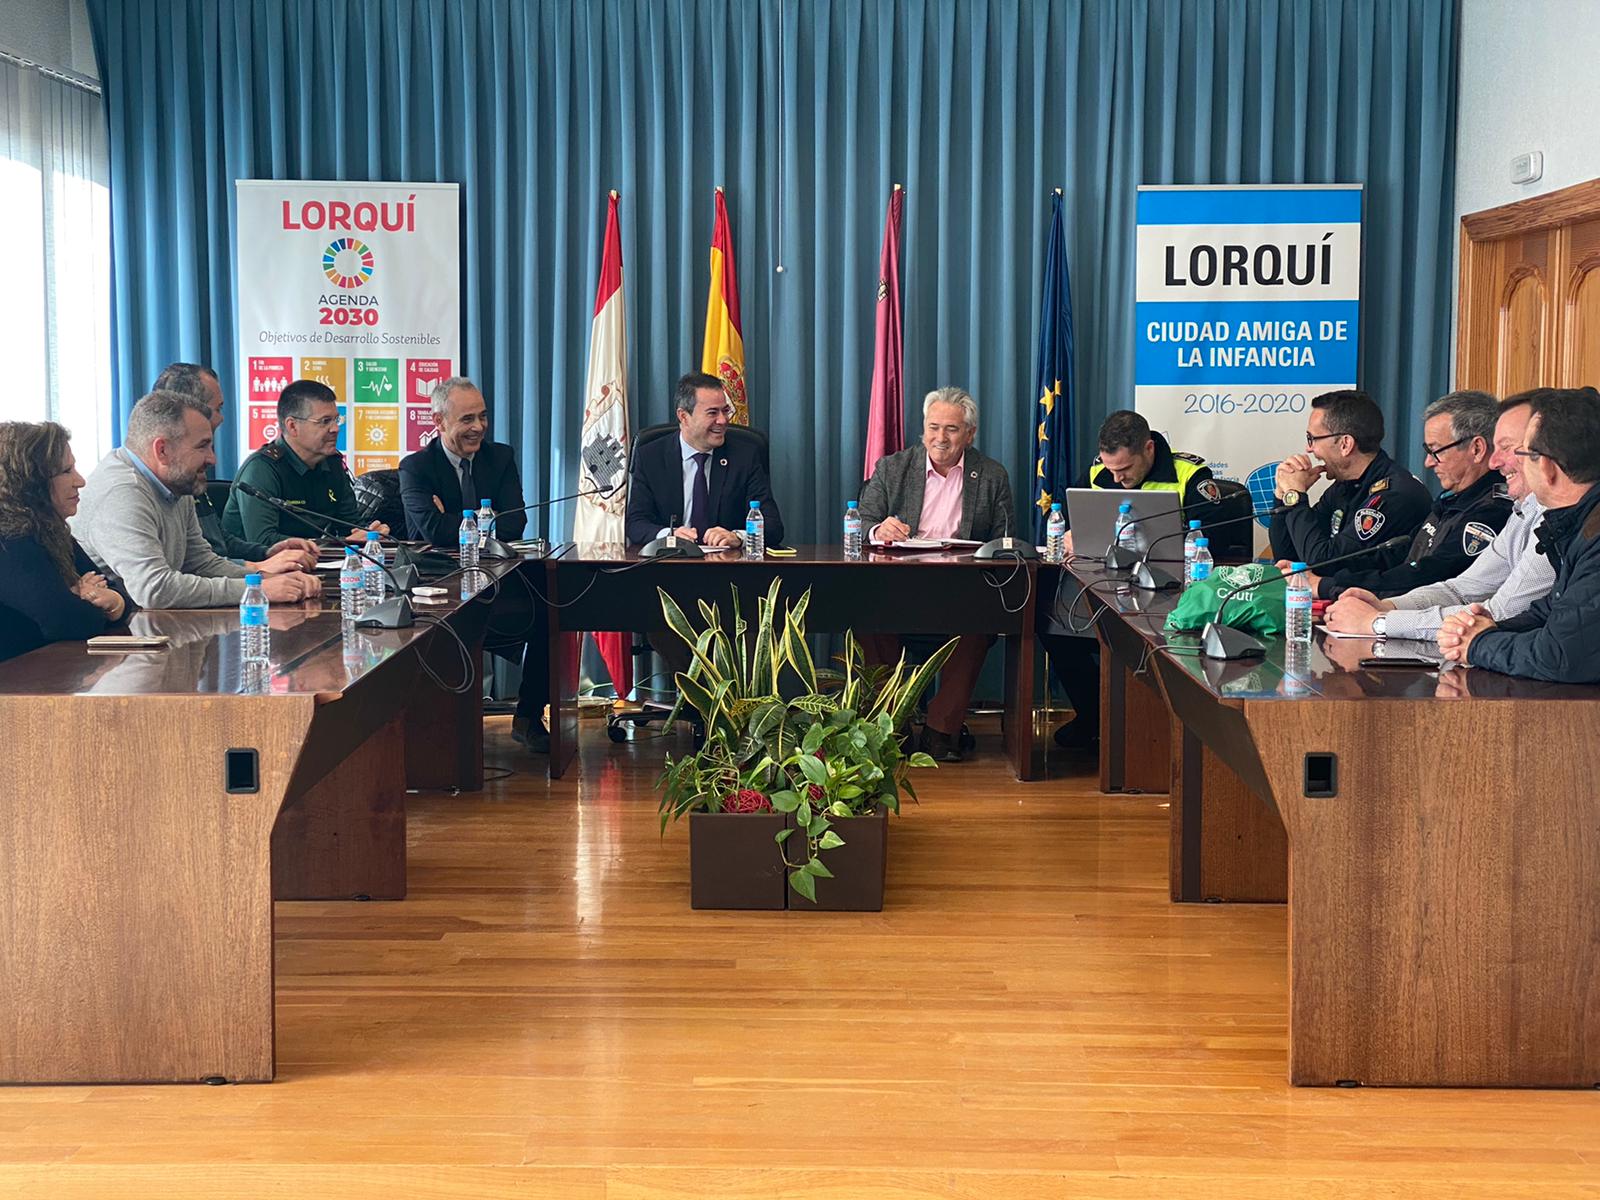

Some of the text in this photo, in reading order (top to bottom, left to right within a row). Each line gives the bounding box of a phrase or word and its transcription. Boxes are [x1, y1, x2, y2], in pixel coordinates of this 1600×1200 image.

[282, 194, 417, 232] LORQUÍ
[1165, 232, 1334, 287] LORQUÍ
[318, 294, 379, 306] AGENDA
[319, 307, 379, 326] 2030
[1147, 320, 1348, 343] CIUDAD AMIGA DE
[259, 331, 441, 346] Objetivos de Desarrollo Sostenibles
[1177, 346, 1316, 368] LA INFANCIA
[252, 360, 257, 371] 1
[304, 360, 311, 371] 2
[357, 361, 364, 372] 3
[410, 361, 416, 373] 4
[1184, 393, 1306, 414] 2016-2020
[252, 408, 259, 419] 5
[358, 409, 364, 420] 7
[410, 409, 416, 421] 8
[357, 458, 365, 469] 11
